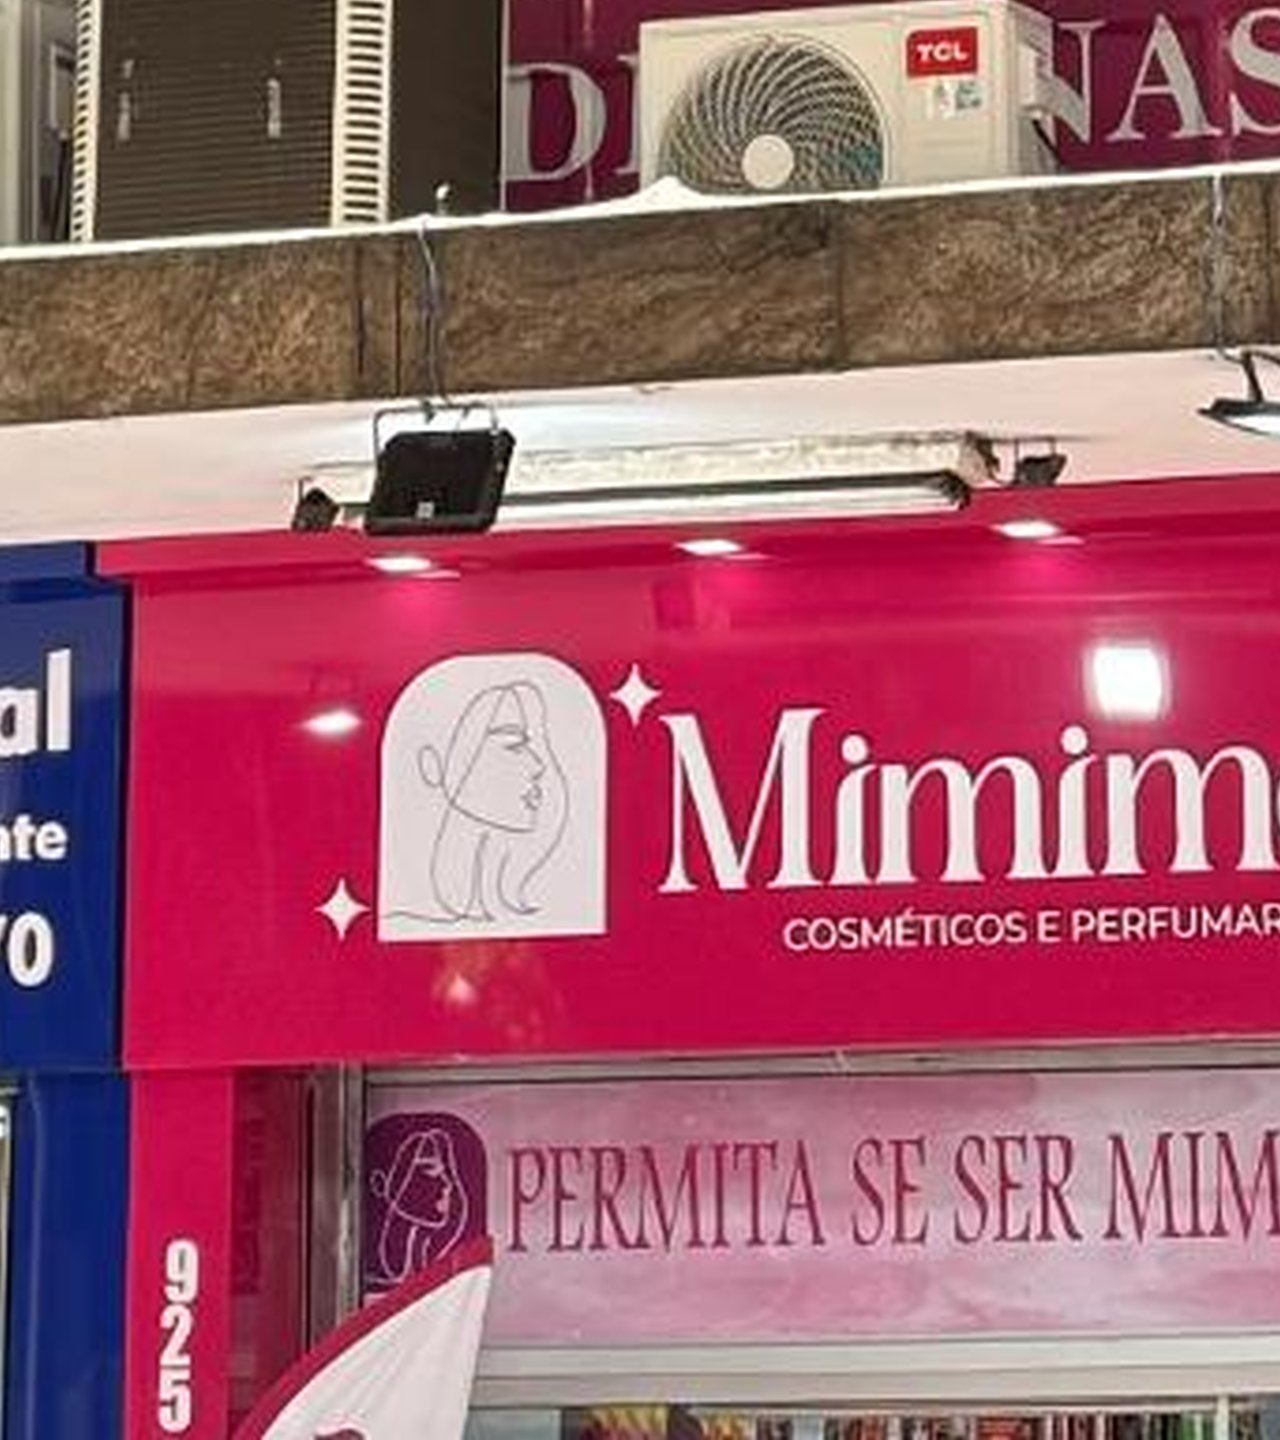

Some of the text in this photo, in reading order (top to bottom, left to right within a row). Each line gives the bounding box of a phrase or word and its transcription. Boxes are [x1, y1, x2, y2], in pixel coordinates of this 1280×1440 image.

[916, 41, 969, 62] TCL
[782, 906, 1028, 952] COSMÉTICOS
[1038, 911, 1061, 943] E
[507, 1137, 827, 1252] PERMITA
[851, 1136, 927, 1245] SE
[953, 1134, 1083, 1243] SER
[158, 1239, 199, 1432] 925
